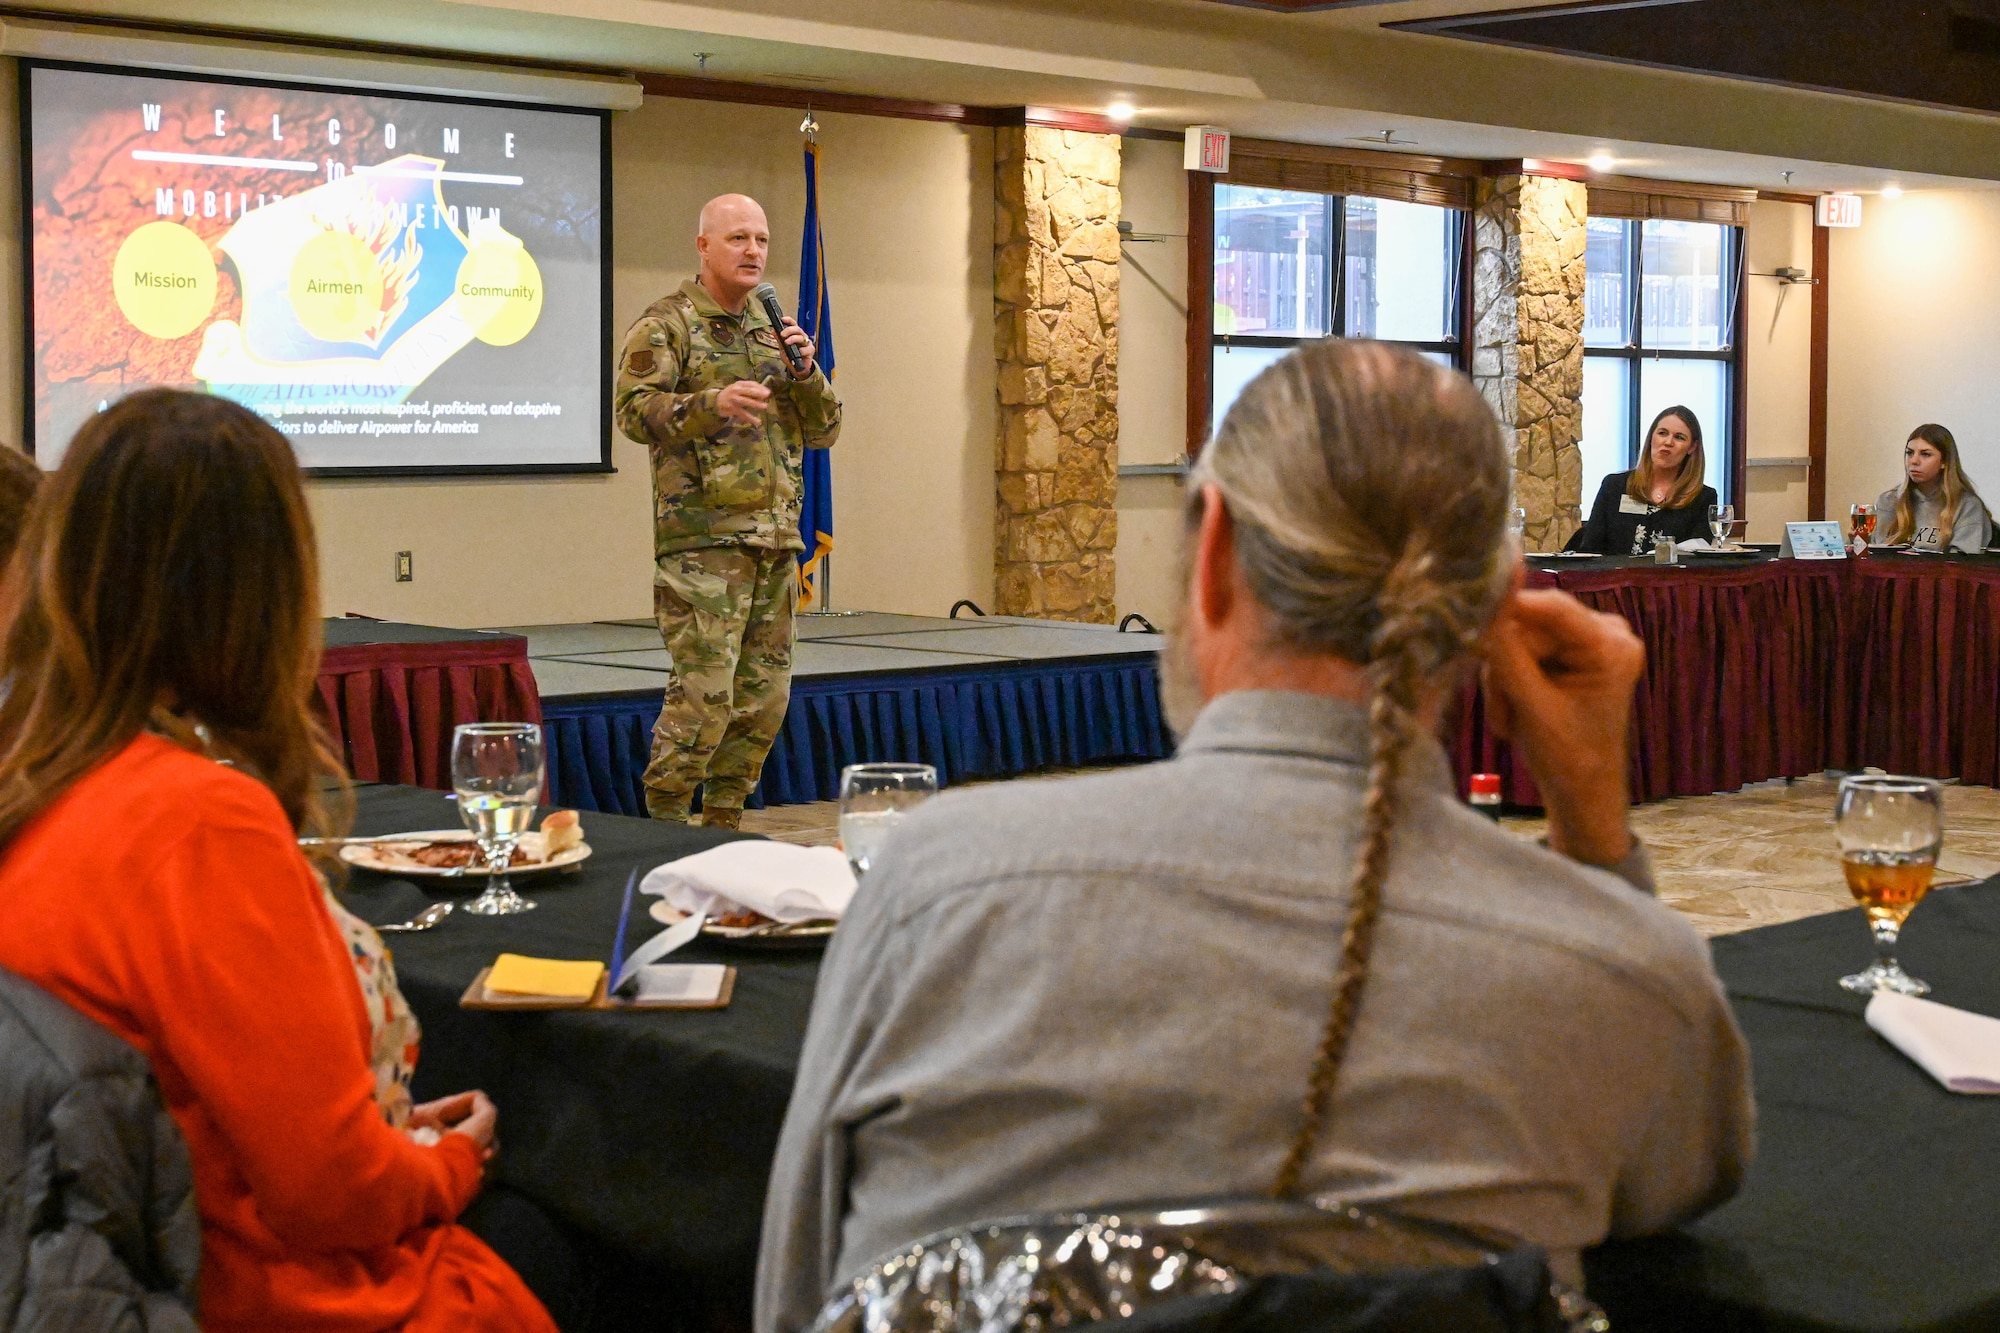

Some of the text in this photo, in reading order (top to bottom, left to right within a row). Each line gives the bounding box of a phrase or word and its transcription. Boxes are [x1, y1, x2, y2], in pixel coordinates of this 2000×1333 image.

[142, 103, 515, 158] WELCOME
[1204, 133, 1226, 168] EXIT
[326, 158, 346, 183] to
[1827, 197, 1858, 223] EXIT
[134, 271, 197, 289] Mission
[306, 279, 363, 295] Airmen
[461, 283, 535, 302] Community
[285, 400, 304, 415] the
[307, 400, 349, 415] world's
[350, 403, 380, 415] most
[382, 401, 431, 418] inspired,
[432, 400, 488, 418] proficient,
[490, 401, 513, 415] and
[514, 401, 561, 418] adaptive
[303, 421, 317, 434] to
[318, 420, 359, 434] deliver
[360, 420, 413, 437] Airpower
[414, 419, 432, 434] for
[432, 420, 479, 434] America
